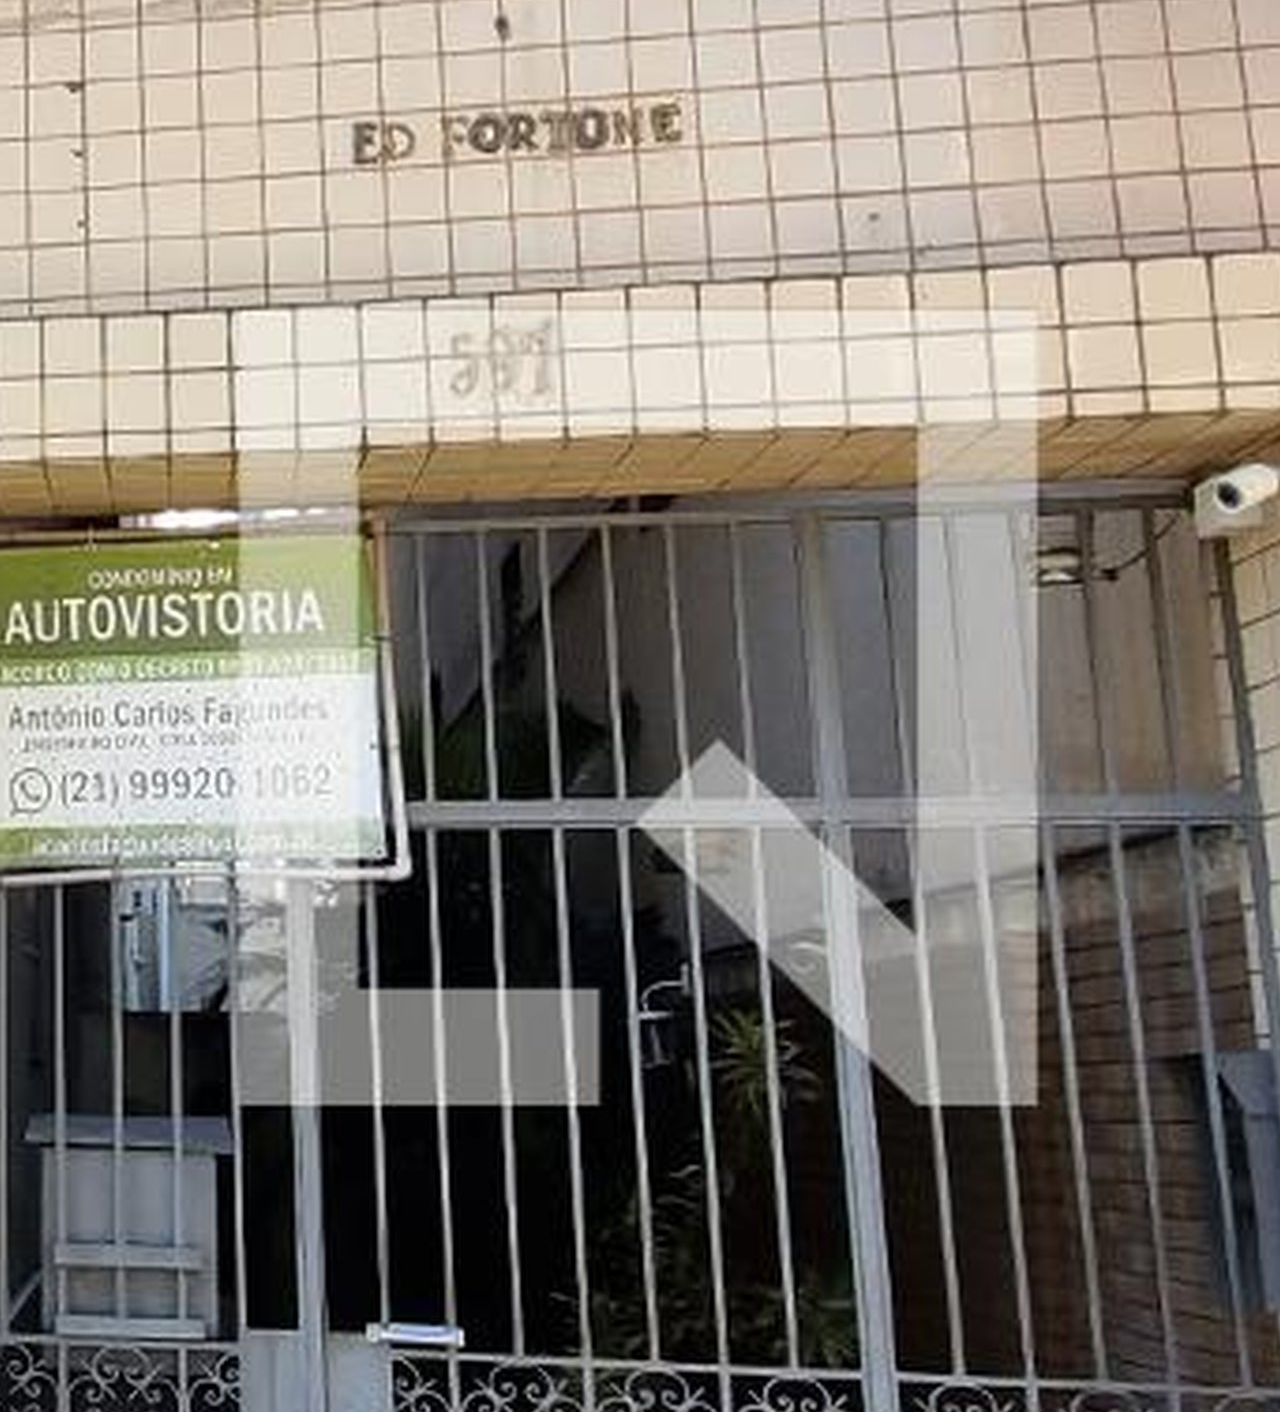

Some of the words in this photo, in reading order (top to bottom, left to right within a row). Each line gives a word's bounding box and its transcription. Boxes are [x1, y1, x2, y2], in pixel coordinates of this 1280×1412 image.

[351, 120, 416, 165] ED
[4, 588, 324, 646] AUTOVISTORIA
[114, 696, 196, 728] Carlos
[203, 695, 328, 729] Fagundes
[60, 770, 119, 808] (21)
